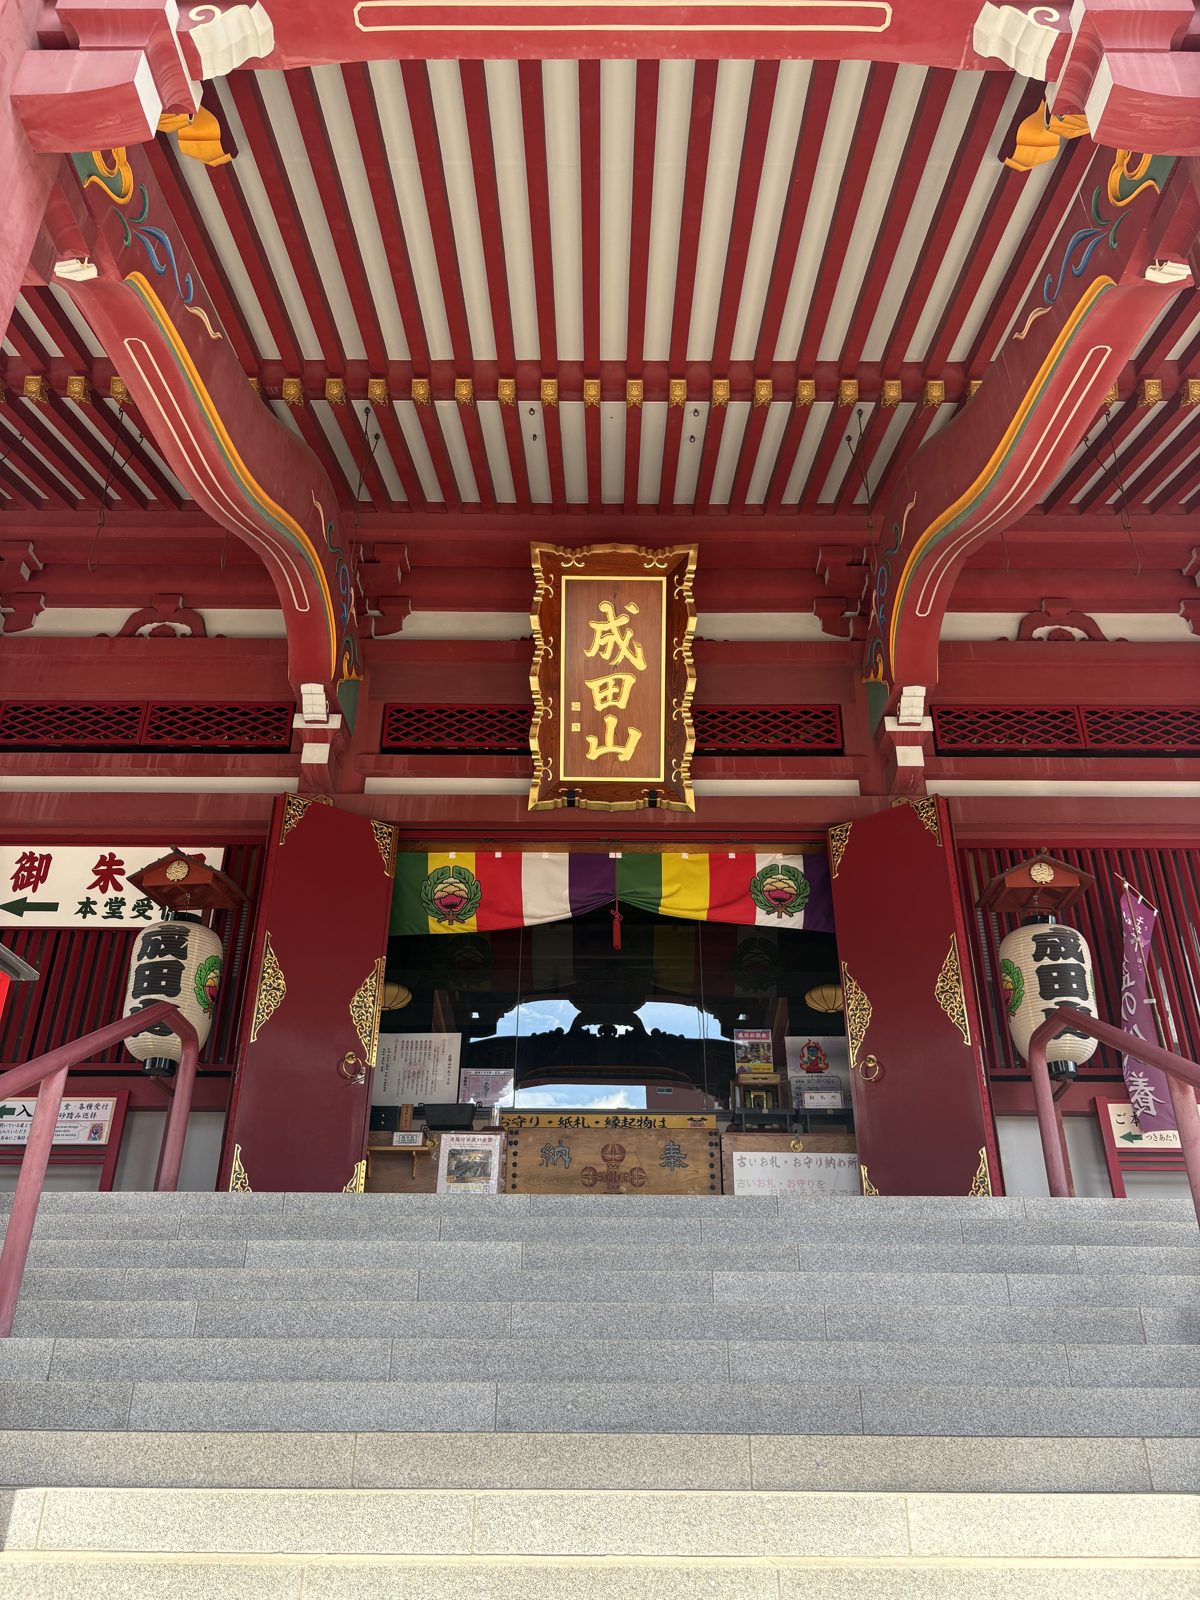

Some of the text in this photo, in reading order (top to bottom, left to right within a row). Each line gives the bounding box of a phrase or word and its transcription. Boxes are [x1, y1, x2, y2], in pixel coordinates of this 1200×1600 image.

[584, 600, 648, 762] 成田山
[10, 850, 206, 894] 御朱
[1146, 1133, 1178, 1142] つきあたり
[539, 1139, 572, 1169] 納
[658, 1140, 689, 1171] 奉
[737, 1155, 857, 1170] 古いお札・お守り納め所
[736, 1179, 826, 1189] 古いお札・お守りを
